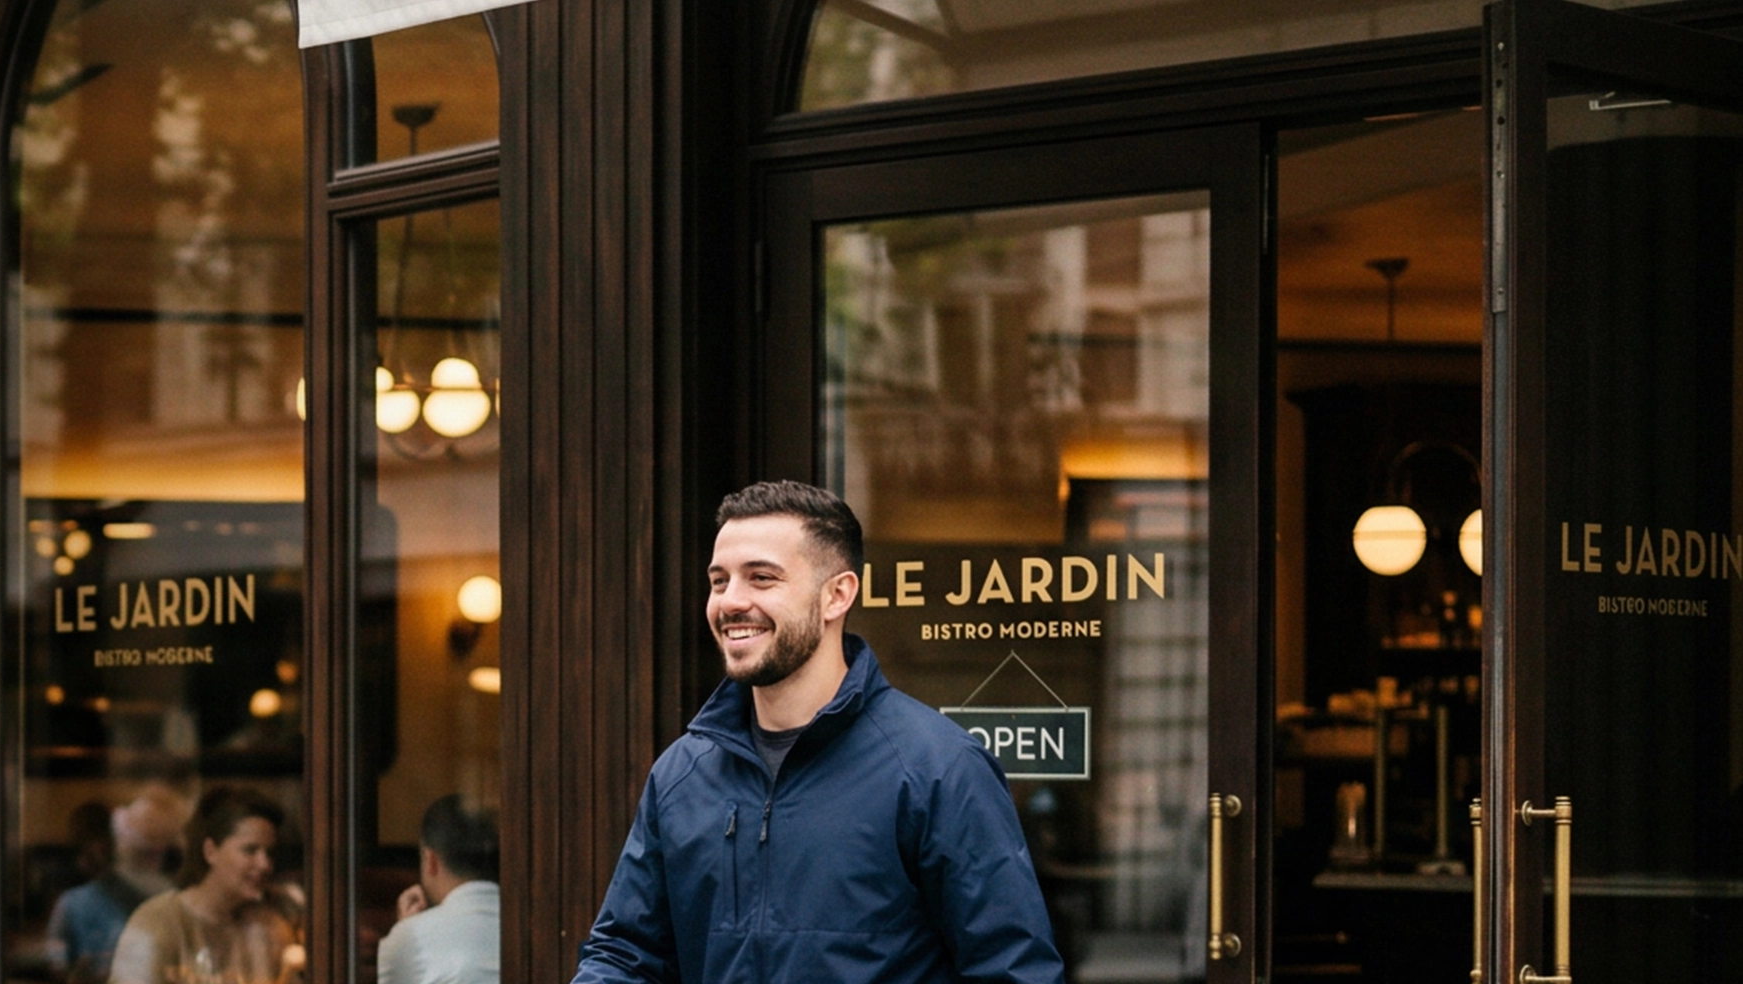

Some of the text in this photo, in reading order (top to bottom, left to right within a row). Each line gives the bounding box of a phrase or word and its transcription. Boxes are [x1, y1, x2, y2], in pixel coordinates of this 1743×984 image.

[1561, 521, 1743, 580] LE JARDIN
[55, 574, 255, 633] LE JARDIN
[861, 553, 1165, 608] LE JARDIN
[921, 620, 1102, 641] BISTRO MODERNE
